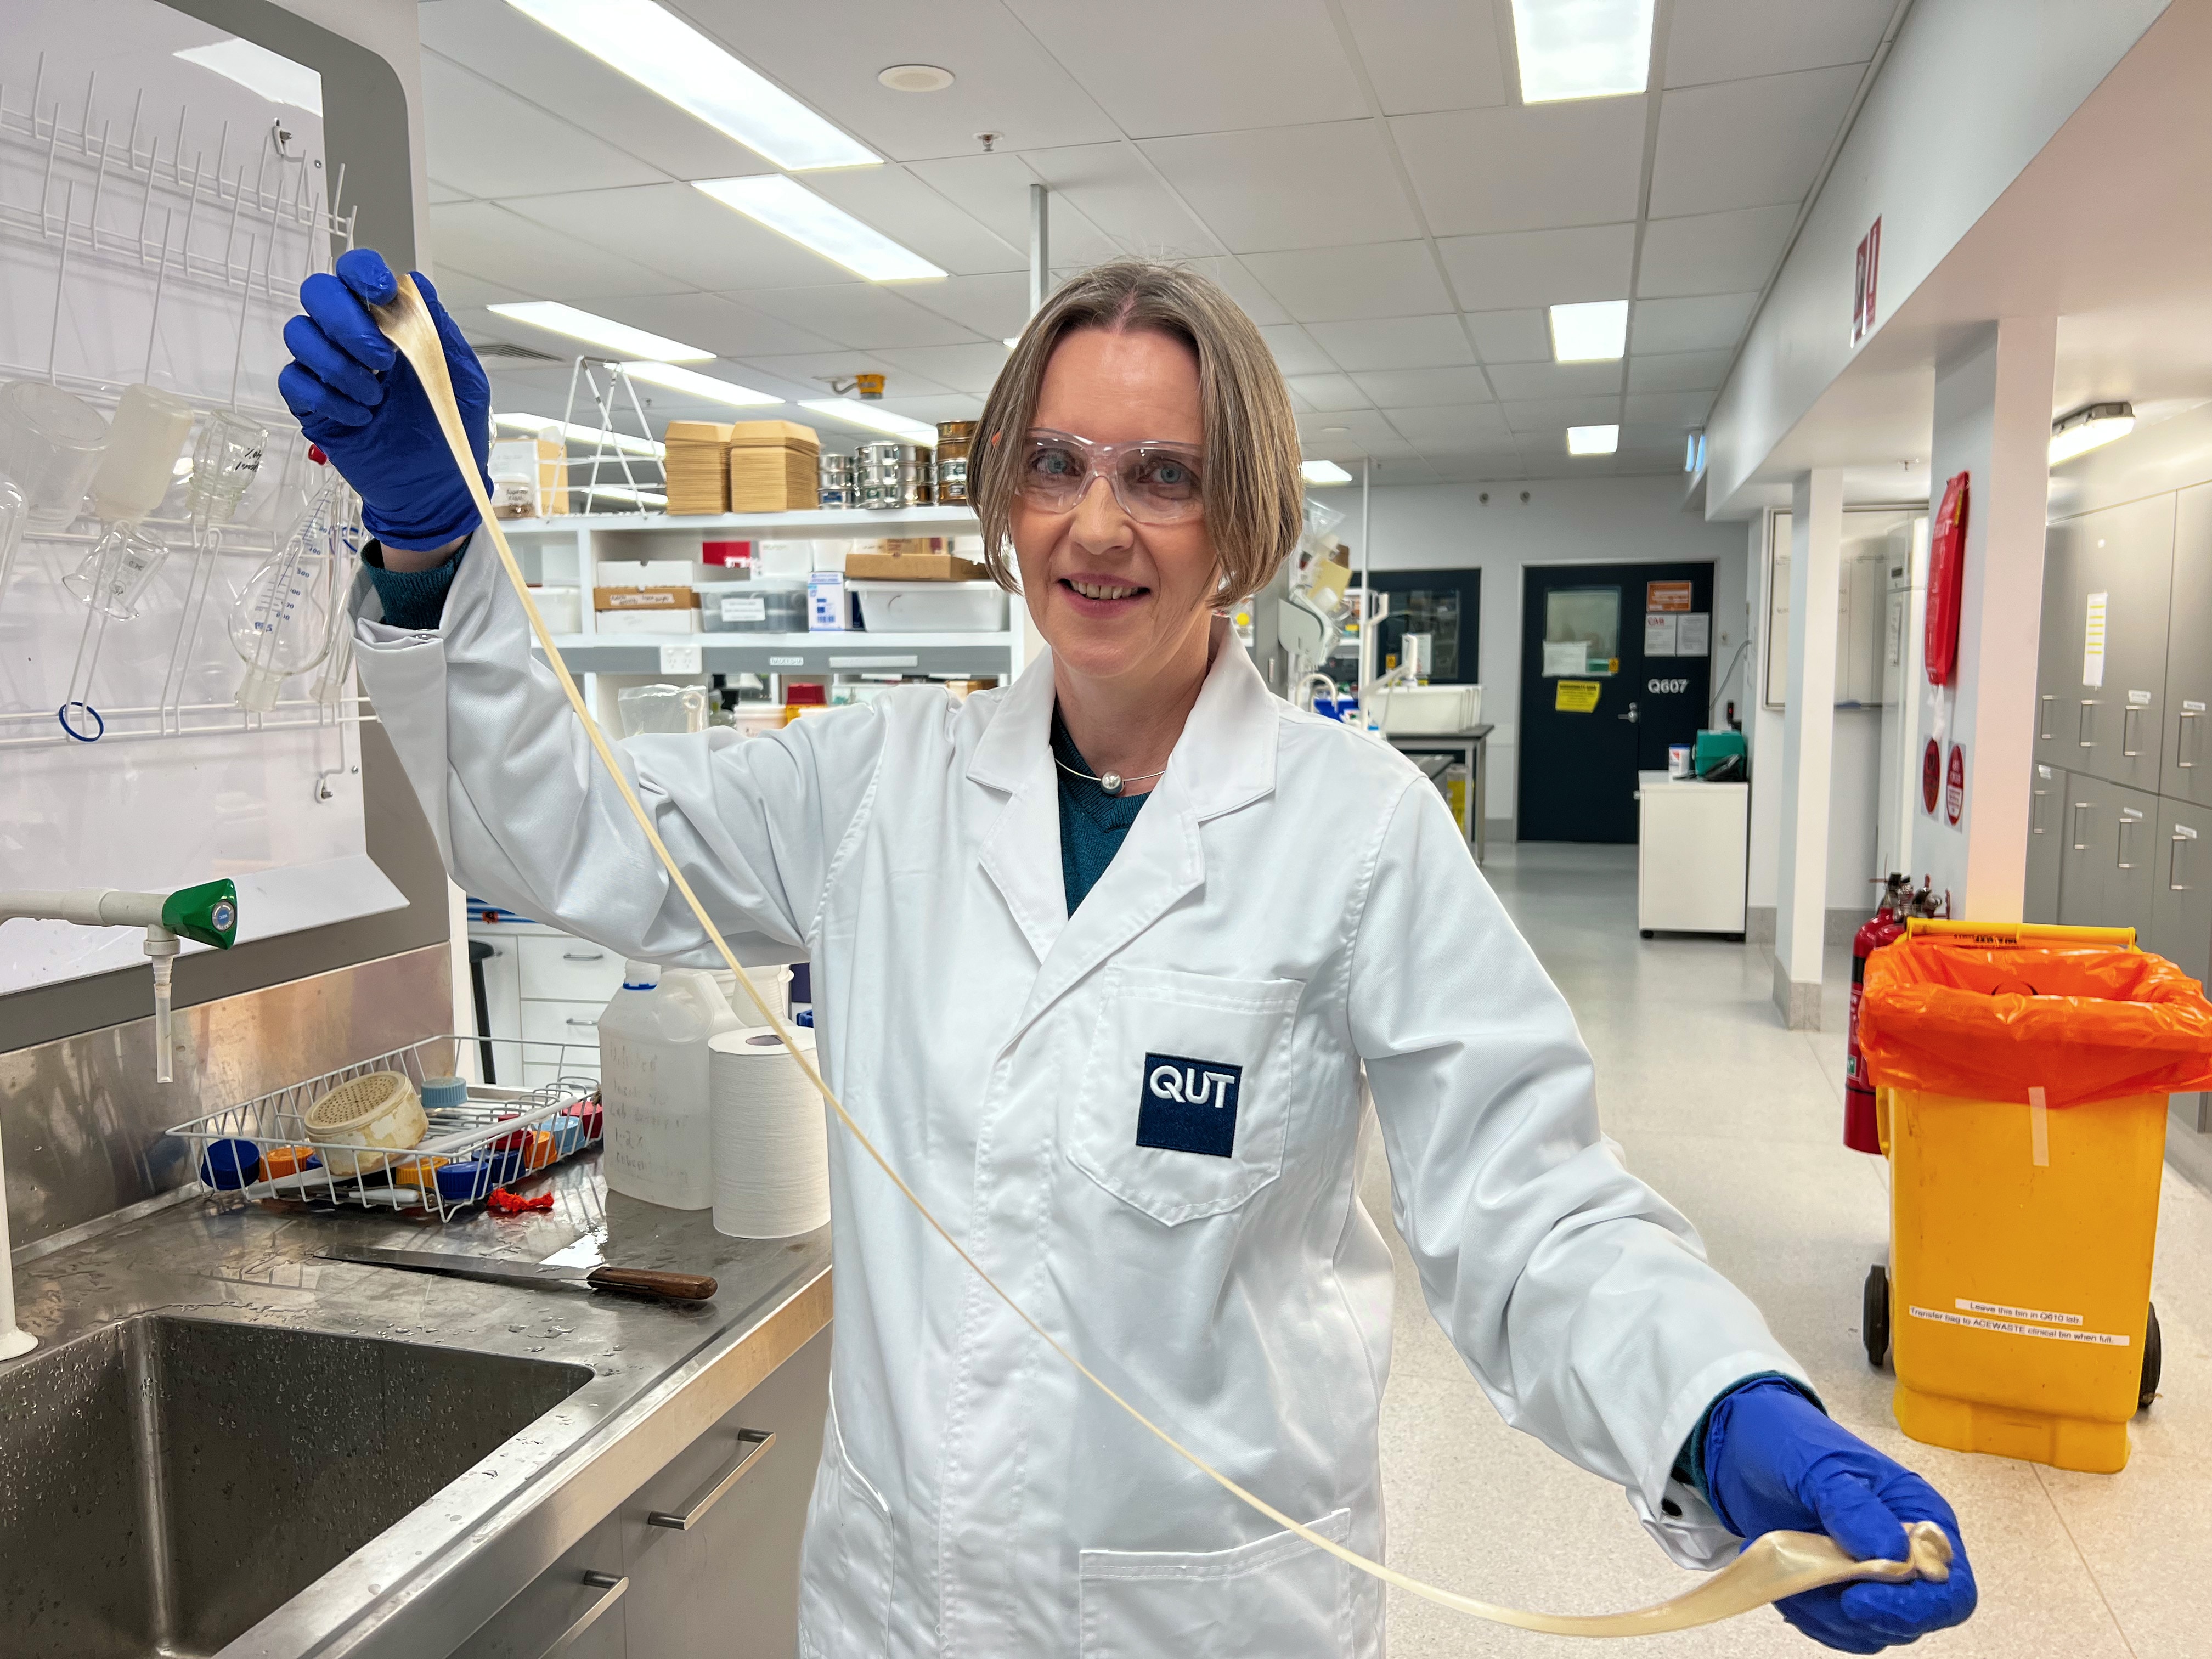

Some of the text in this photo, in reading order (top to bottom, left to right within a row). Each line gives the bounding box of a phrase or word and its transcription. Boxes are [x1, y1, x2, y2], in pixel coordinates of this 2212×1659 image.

[1647, 678, 1689, 694] Q607
[1150, 1065, 1235, 1108] QUT
[1911, 1307, 1943, 1320] Transfer
[1945, 1313, 1961, 1324] bag
[1963, 1317, 1971, 1325] to
[1973, 1318, 2025, 1334] ACEWASTE
[2028, 1327, 2057, 1337] clinical
[2058, 1331, 2072, 1339] bin
[2073, 1333, 2097, 1342] when
[1970, 1302, 1995, 1312] Leave
[2015, 1309, 2028, 1318] bin
[2030, 1311, 2038, 1319] in
[2040, 1312, 2064, 1322] Q610
